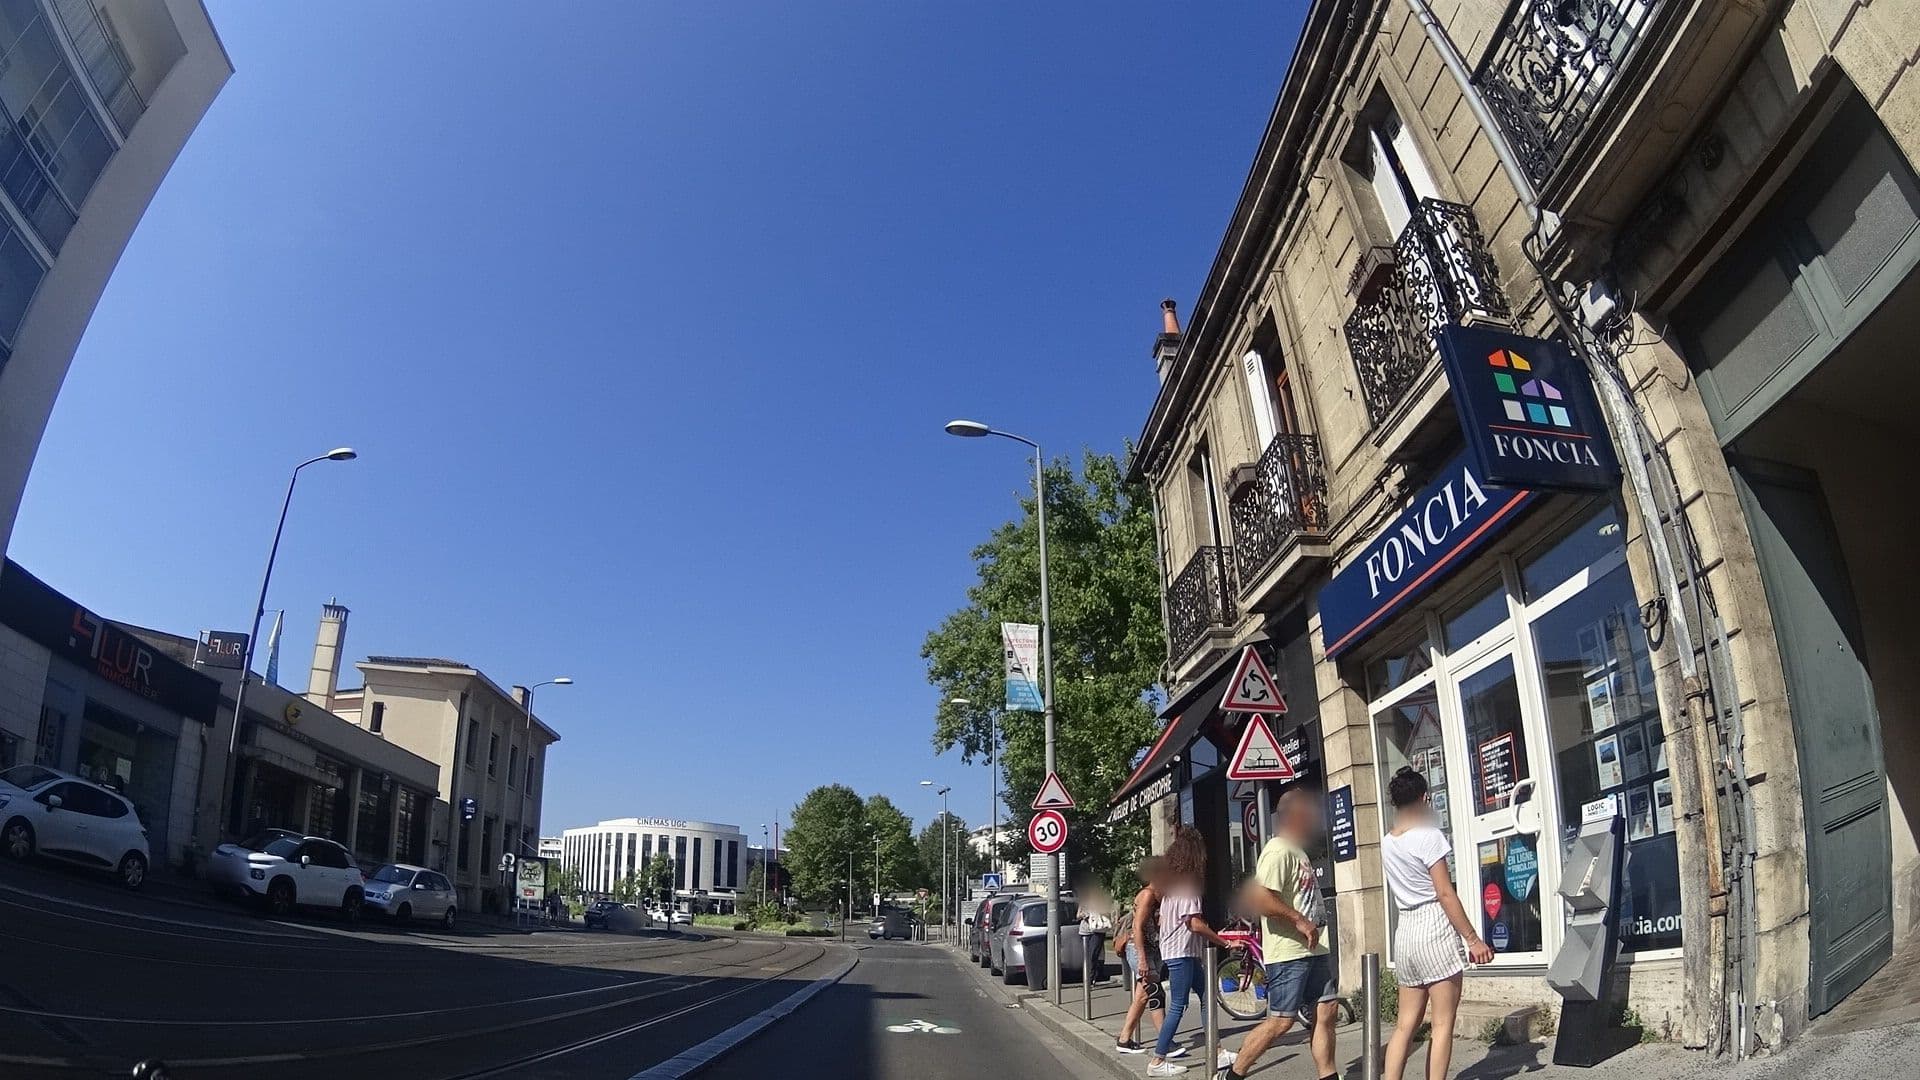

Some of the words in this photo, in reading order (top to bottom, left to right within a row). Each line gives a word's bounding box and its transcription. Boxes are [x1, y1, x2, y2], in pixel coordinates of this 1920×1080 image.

[1493, 434, 1600, 467] FONCIA
[1365, 466, 1489, 599] FONCIA
[1107, 800, 1129, 823] L'ATELIER
[1130, 794, 1138, 813] DE
[1140, 772, 1172, 808] CHRISTOPHE
[1587, 801, 1605, 812] LOGIC
[671, 819, 687, 828] UGC
[1036, 821, 1059, 842] 30
[1516, 851, 1535, 864] LIGNE
